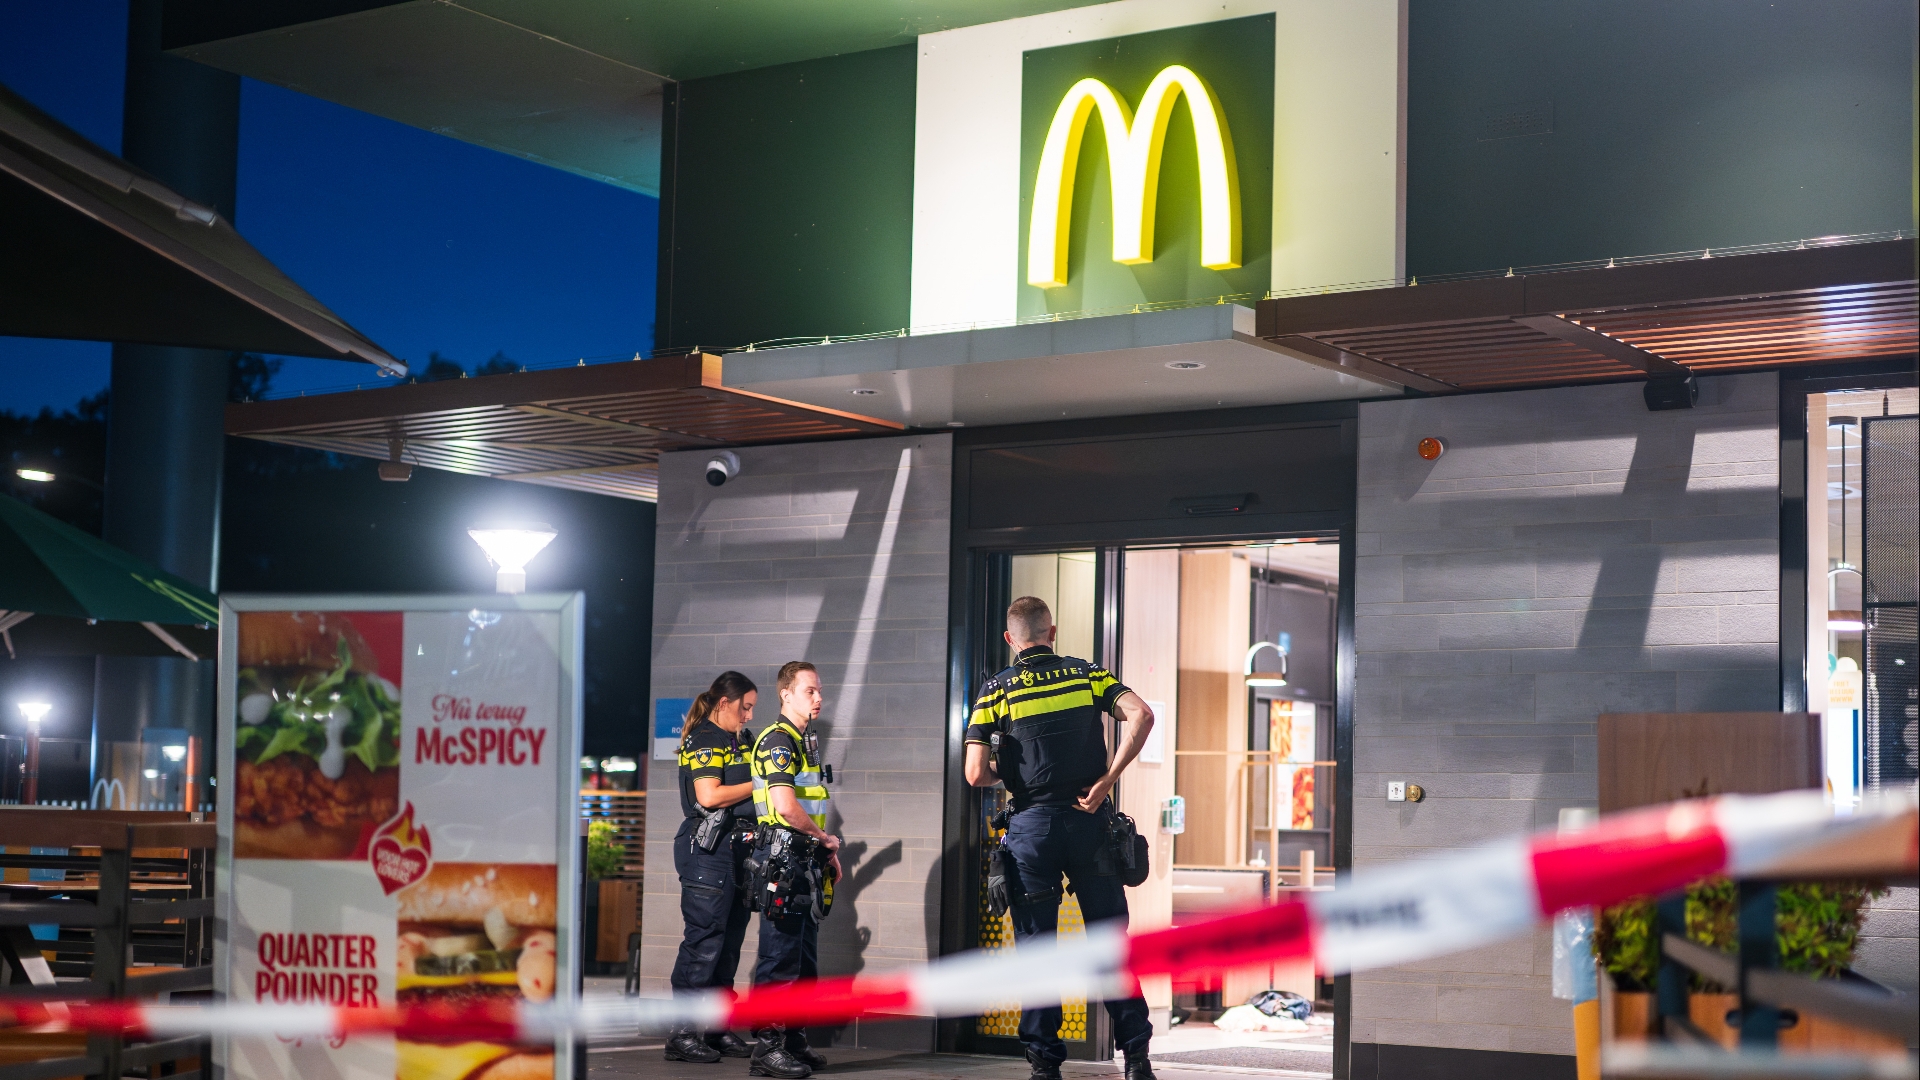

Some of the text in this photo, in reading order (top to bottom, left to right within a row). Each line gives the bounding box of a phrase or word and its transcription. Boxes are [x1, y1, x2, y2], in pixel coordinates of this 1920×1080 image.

[1011, 667, 1080, 687] POLITIE
[475, 702, 526, 727] terug
[415, 726, 547, 766] McSPICY
[257, 932, 377, 972] QUARTER
[255, 971, 378, 1008] POUNDER
